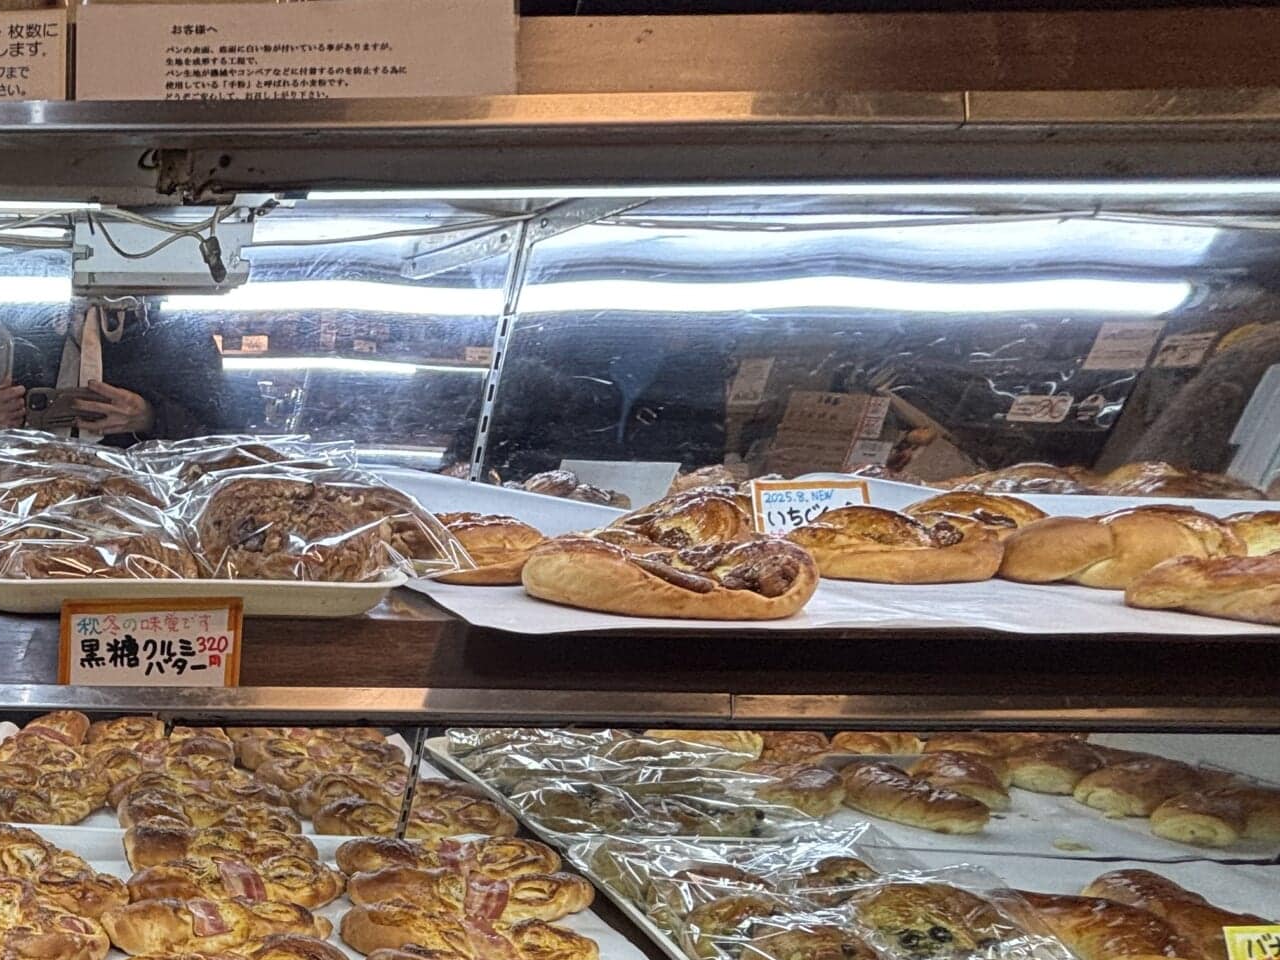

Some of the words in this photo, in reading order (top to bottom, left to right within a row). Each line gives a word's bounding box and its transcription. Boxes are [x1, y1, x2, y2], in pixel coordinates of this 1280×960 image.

[172, 24, 218, 35] お客様へ
[76, 614, 212, 636] 秋冬の味覚です
